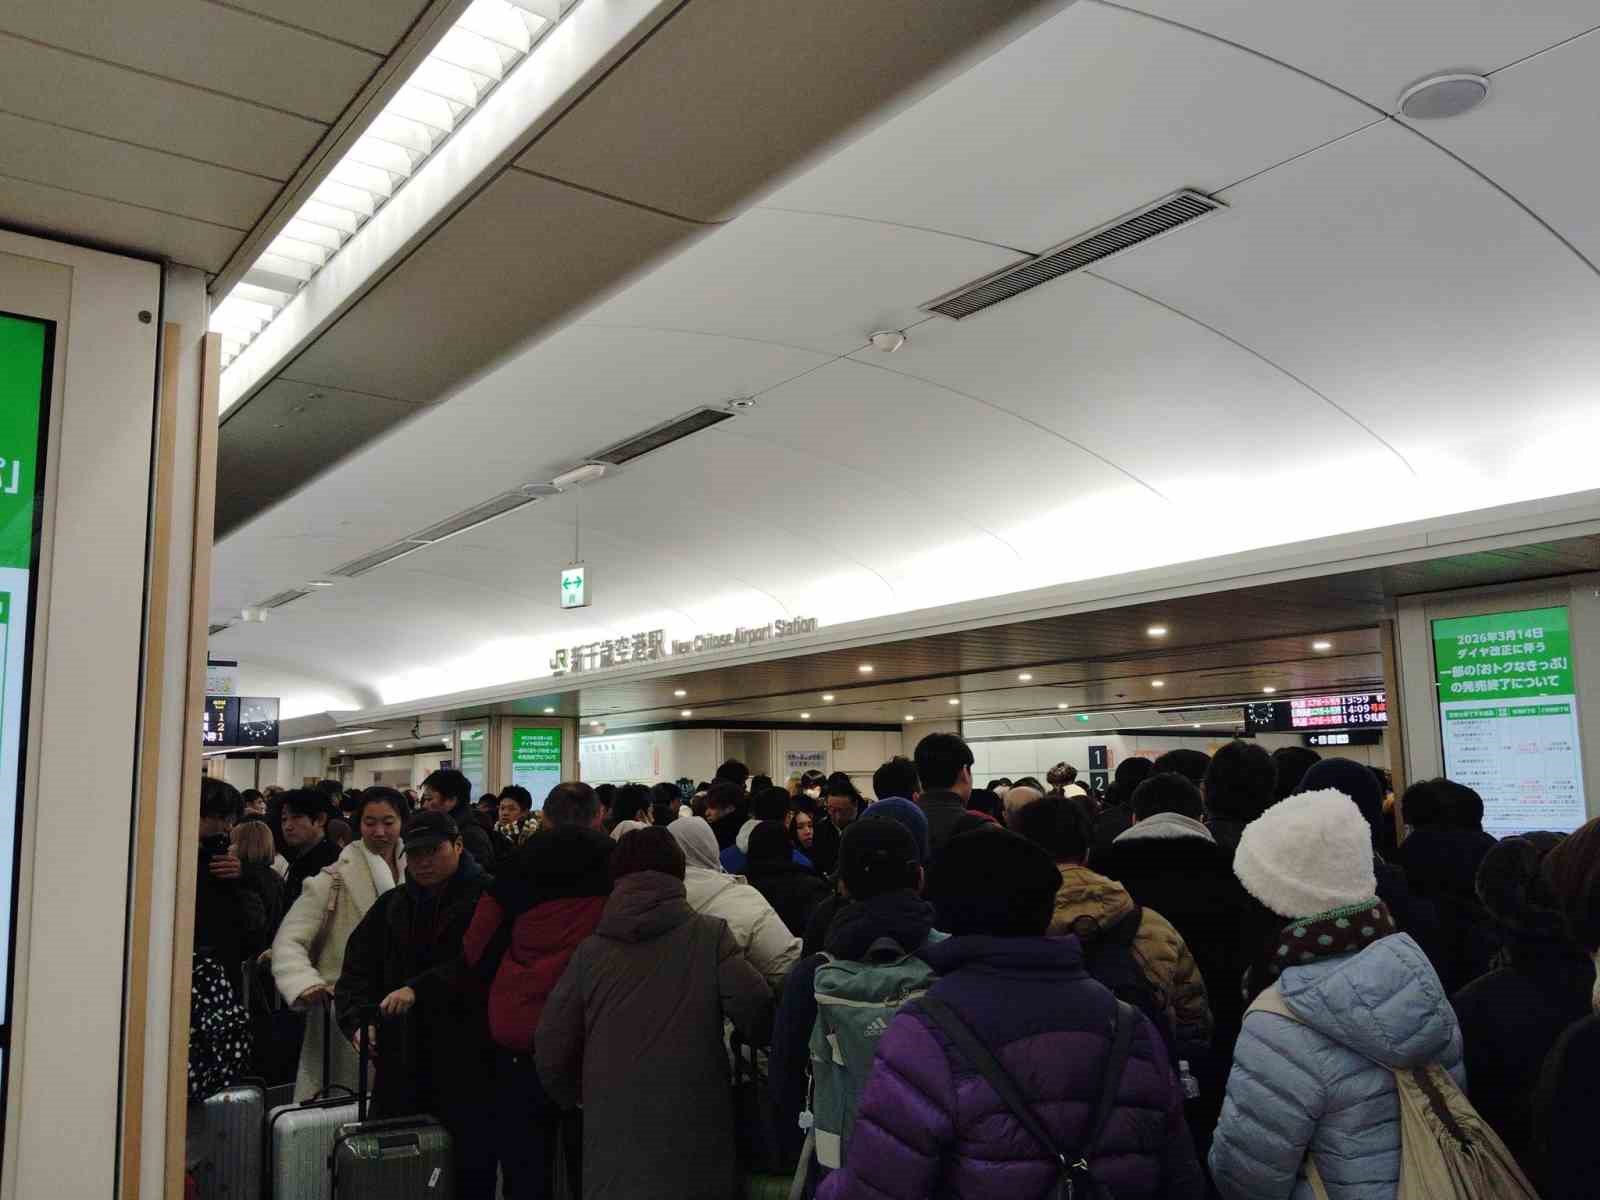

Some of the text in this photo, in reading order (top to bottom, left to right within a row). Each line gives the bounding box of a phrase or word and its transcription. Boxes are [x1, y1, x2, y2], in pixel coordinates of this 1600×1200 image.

[735, 622, 774, 647] Airport
[774, 615, 818, 638] Station
[1457, 627, 1544, 645] 2026年3月14日
[1457, 642, 1546, 659] ダイヤ改正に伴う
[1343, 704, 1370, 714] 14:09
[1344, 714, 1371, 724] 14:19
[217, 722, 225, 732] 2
[1094, 750, 1101, 765] 1
[1095, 776, 1105, 791] 2
